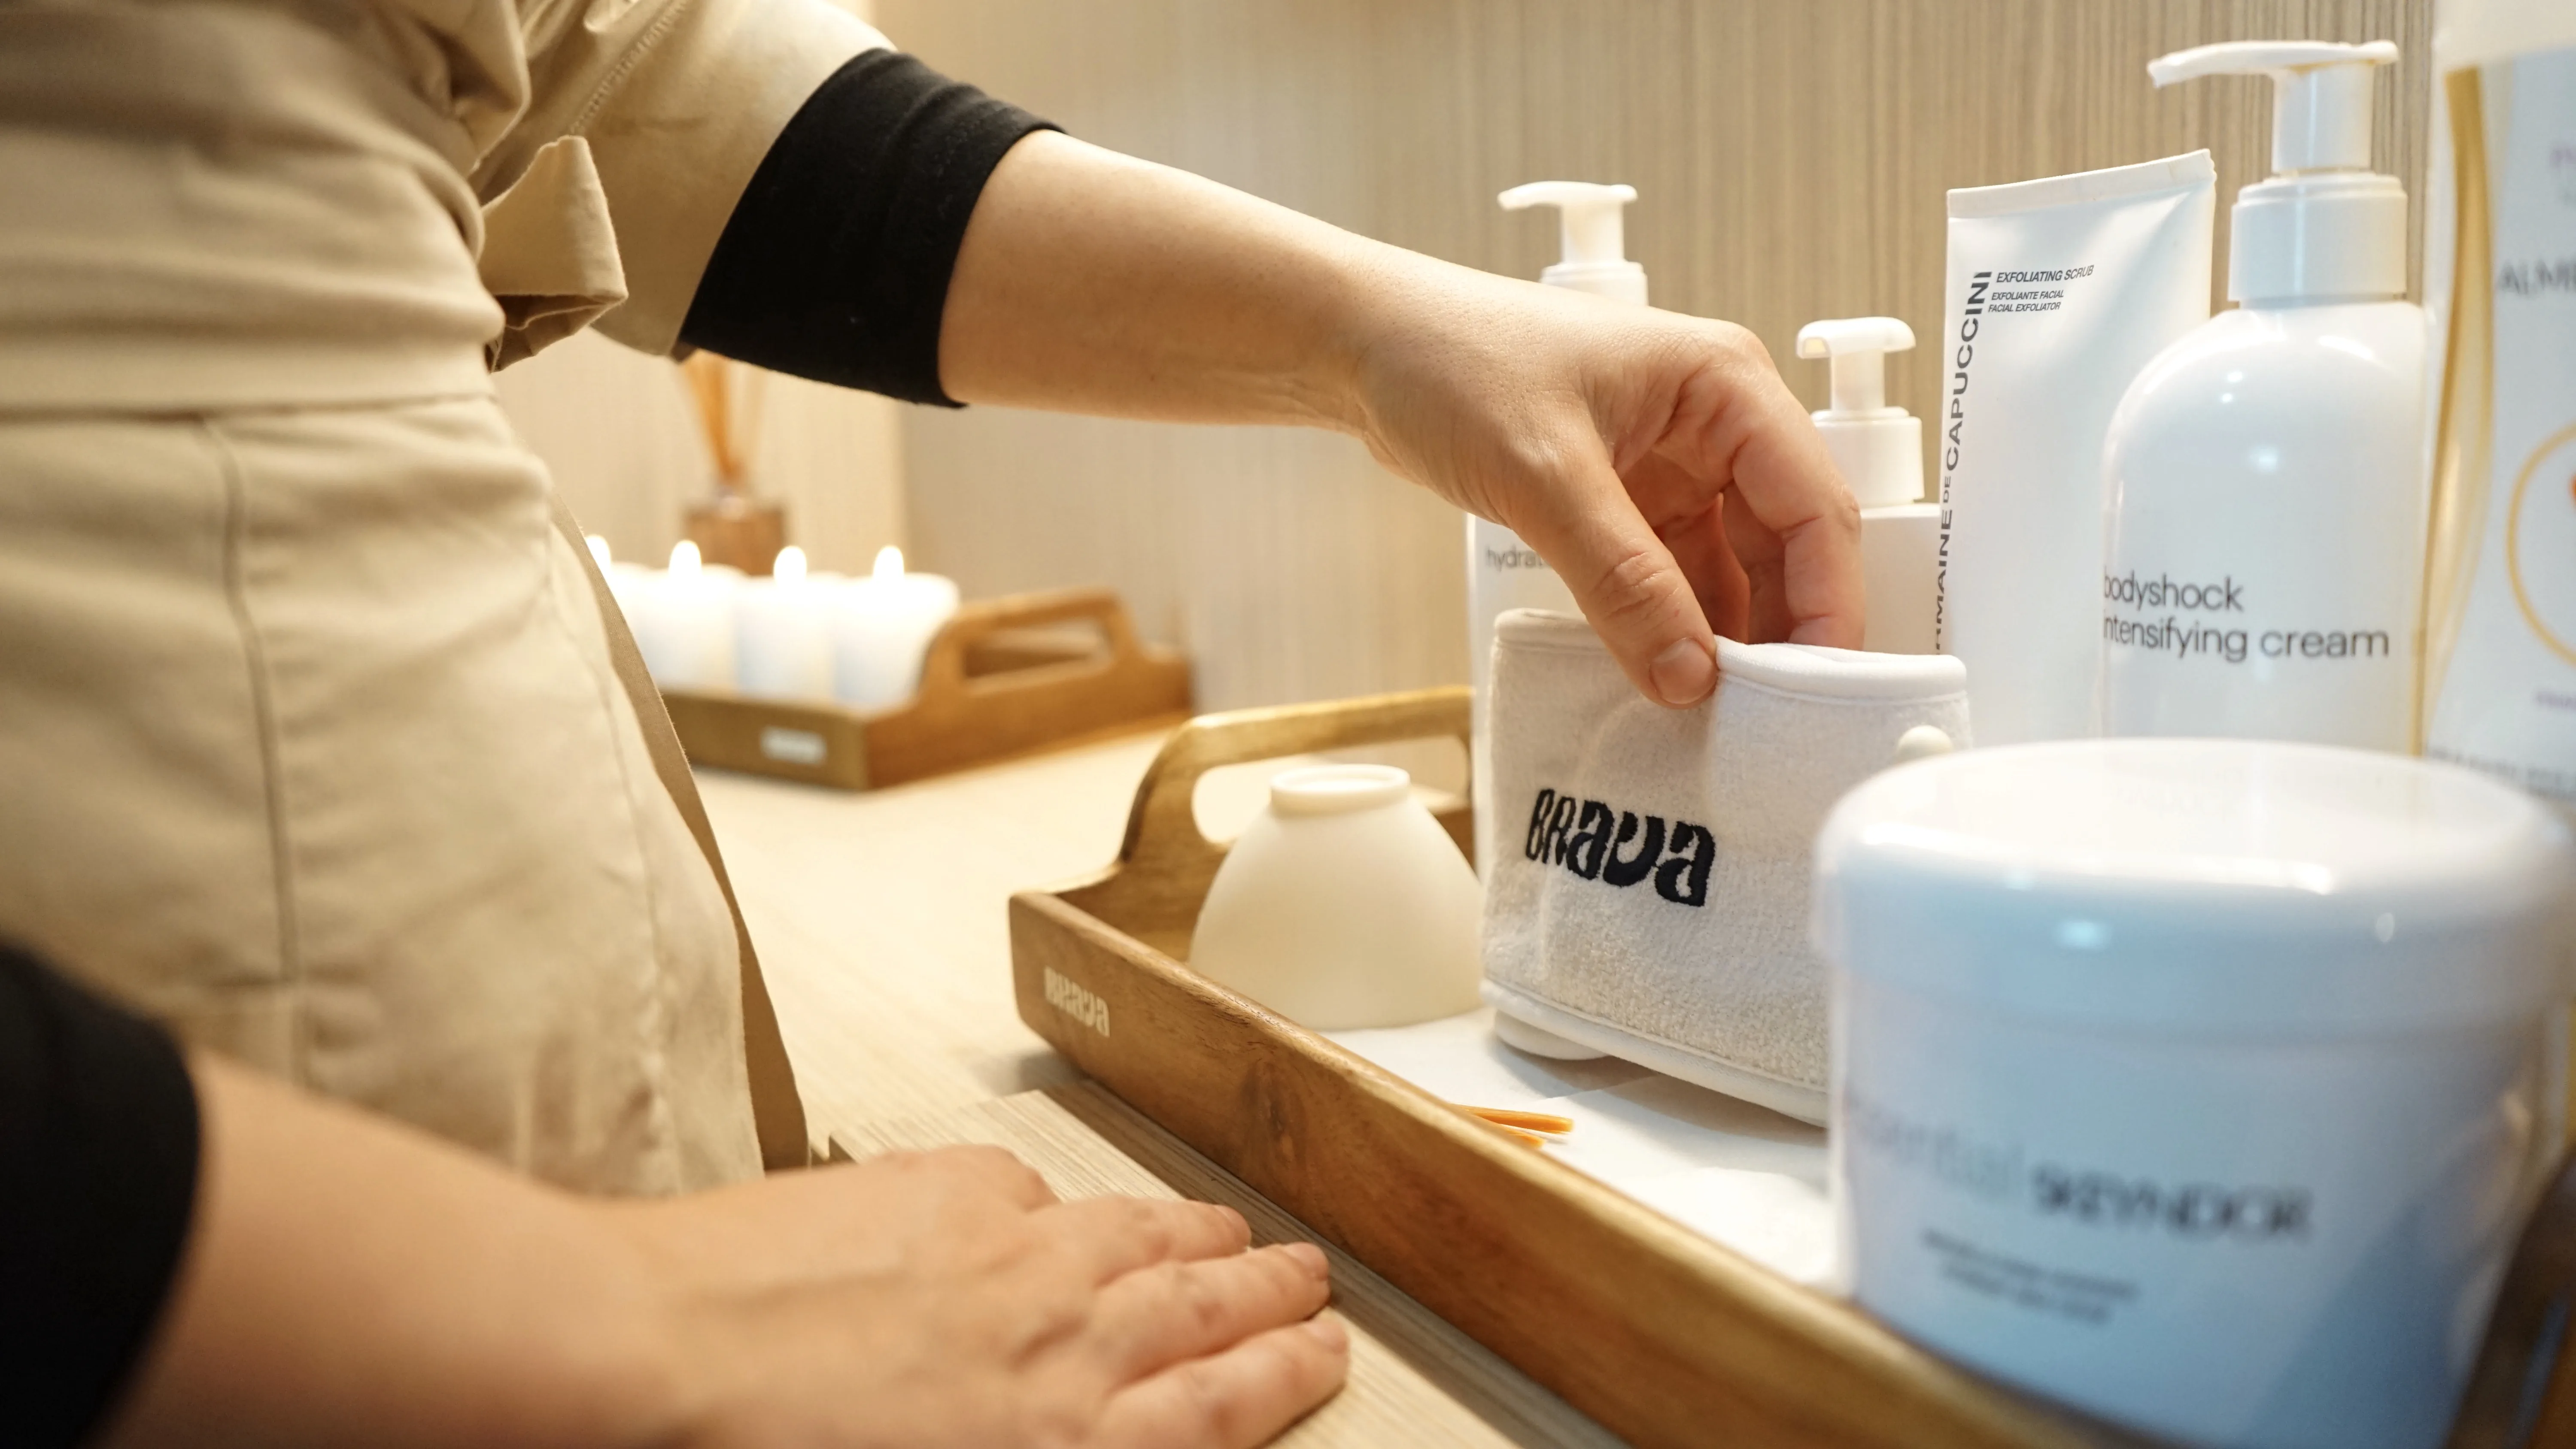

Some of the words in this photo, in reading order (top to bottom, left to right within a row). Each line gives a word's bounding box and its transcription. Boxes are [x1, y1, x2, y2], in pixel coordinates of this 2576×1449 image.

[1996, 270, 2063, 283] EXFOLIATING
[2064, 264, 2095, 281] SCRUB
[1988, 303, 2014, 313] FACIAL
[2015, 301, 2061, 312] EXFOLIATOR
[1991, 291, 2039, 300] EXFOLIANTE
[2039, 289, 2064, 300] FACIAL
[1946, 271, 1993, 471] CAPUCCINI
[1943, 476, 1951, 503] DE
[2104, 564, 2244, 612] bodyshock
[2259, 629, 2390, 659] cream
